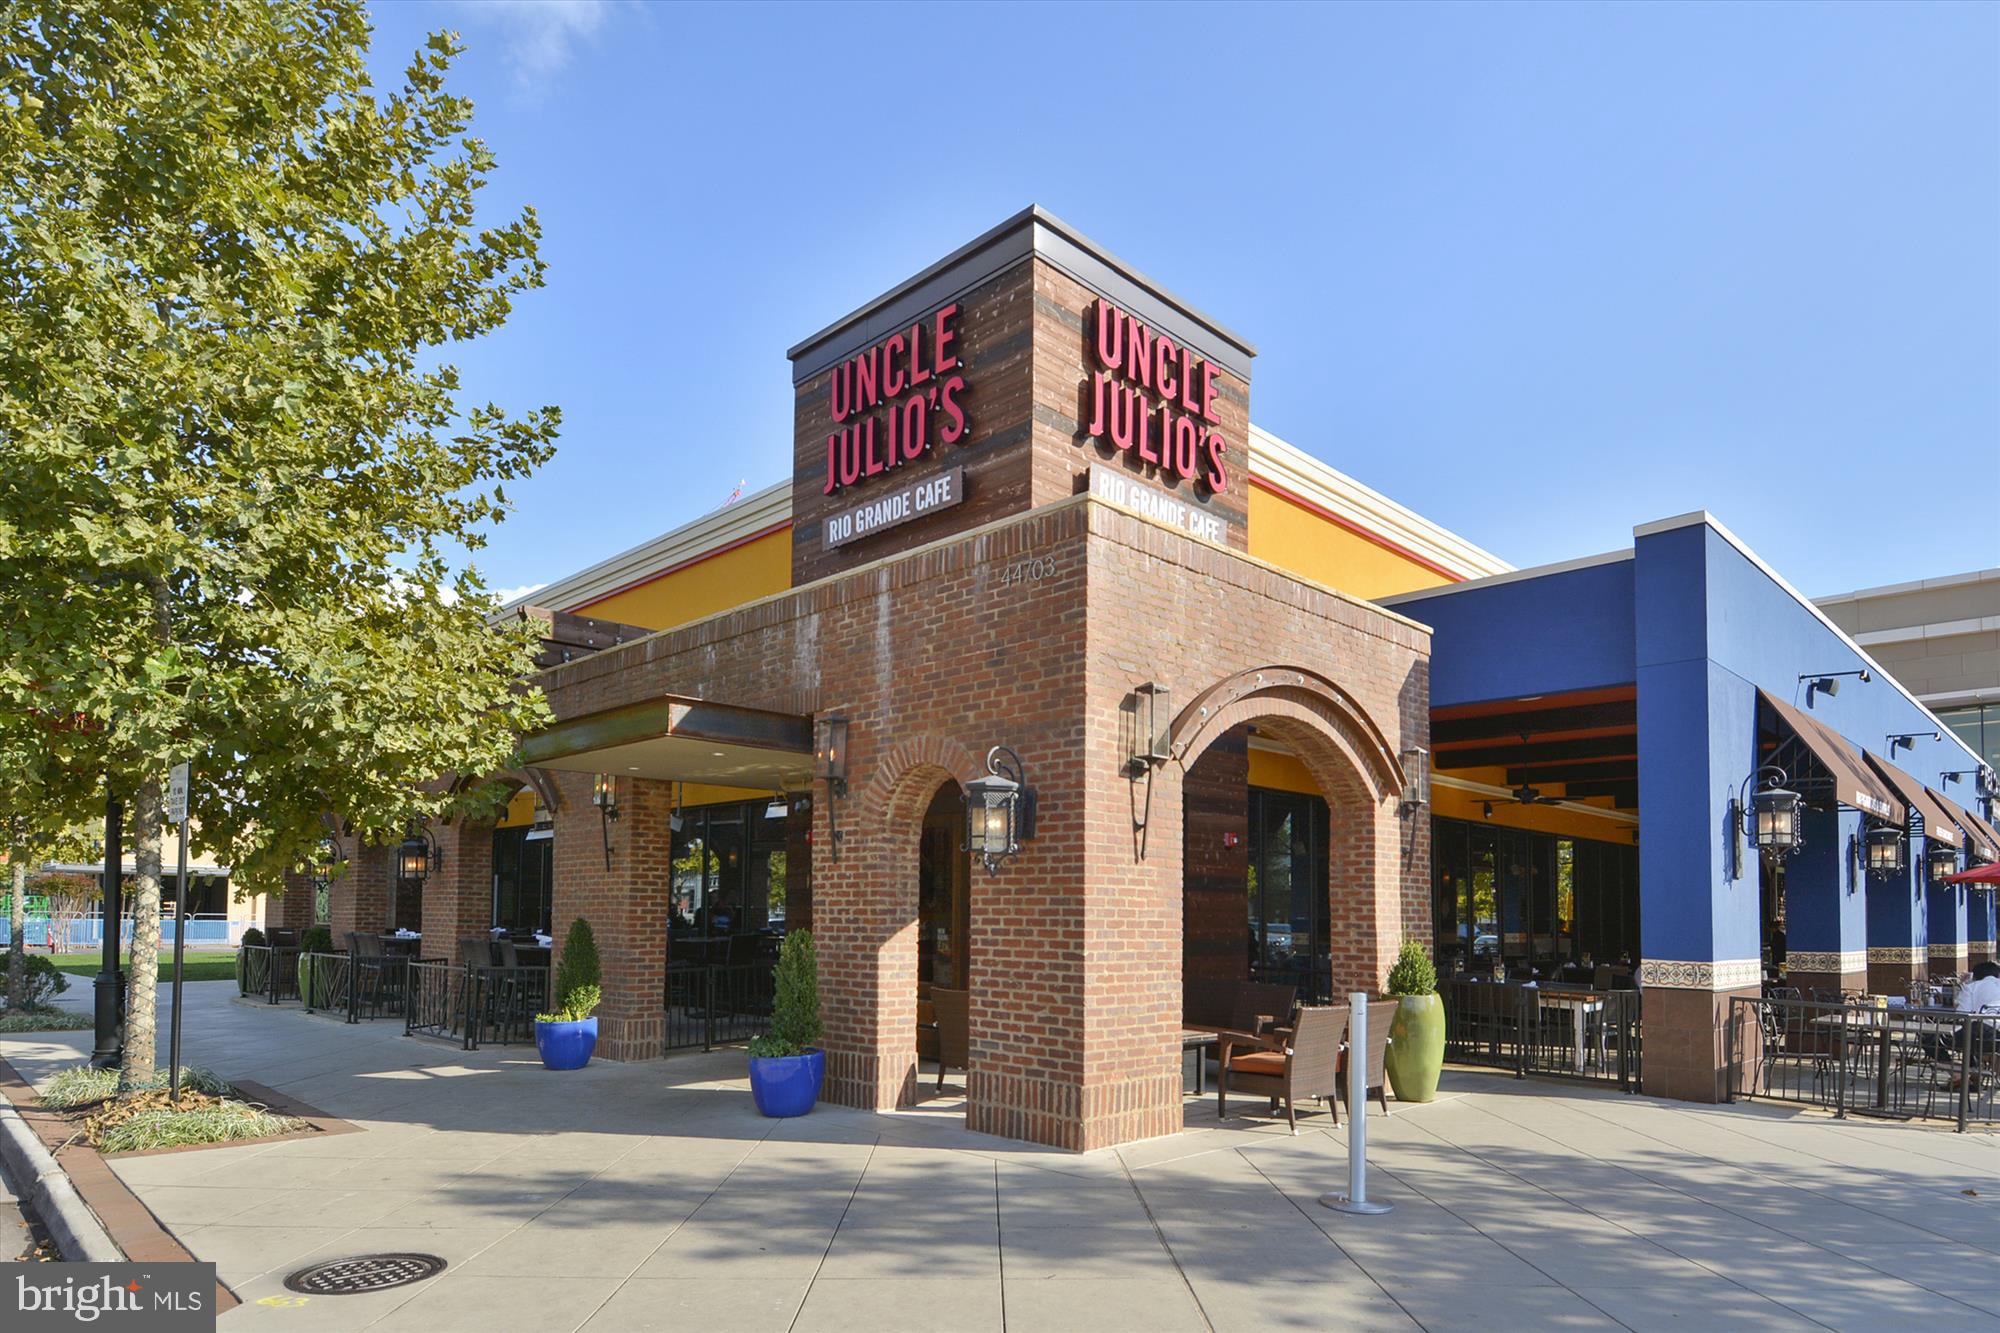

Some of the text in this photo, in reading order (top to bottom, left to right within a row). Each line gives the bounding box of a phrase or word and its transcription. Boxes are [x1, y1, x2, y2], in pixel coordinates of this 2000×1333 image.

[831, 303, 958, 423] UNCLE
[1098, 297, 1222, 425] UNCLE
[823, 375, 965, 495] JULIO'S
[1089, 370, 1228, 494] JULIO'S
[829, 475, 952, 544] RIO GRANDE CAFE
[1100, 471, 1220, 543] RIO GRANDE CAFE
[1001, 556, 1055, 588] 44703
